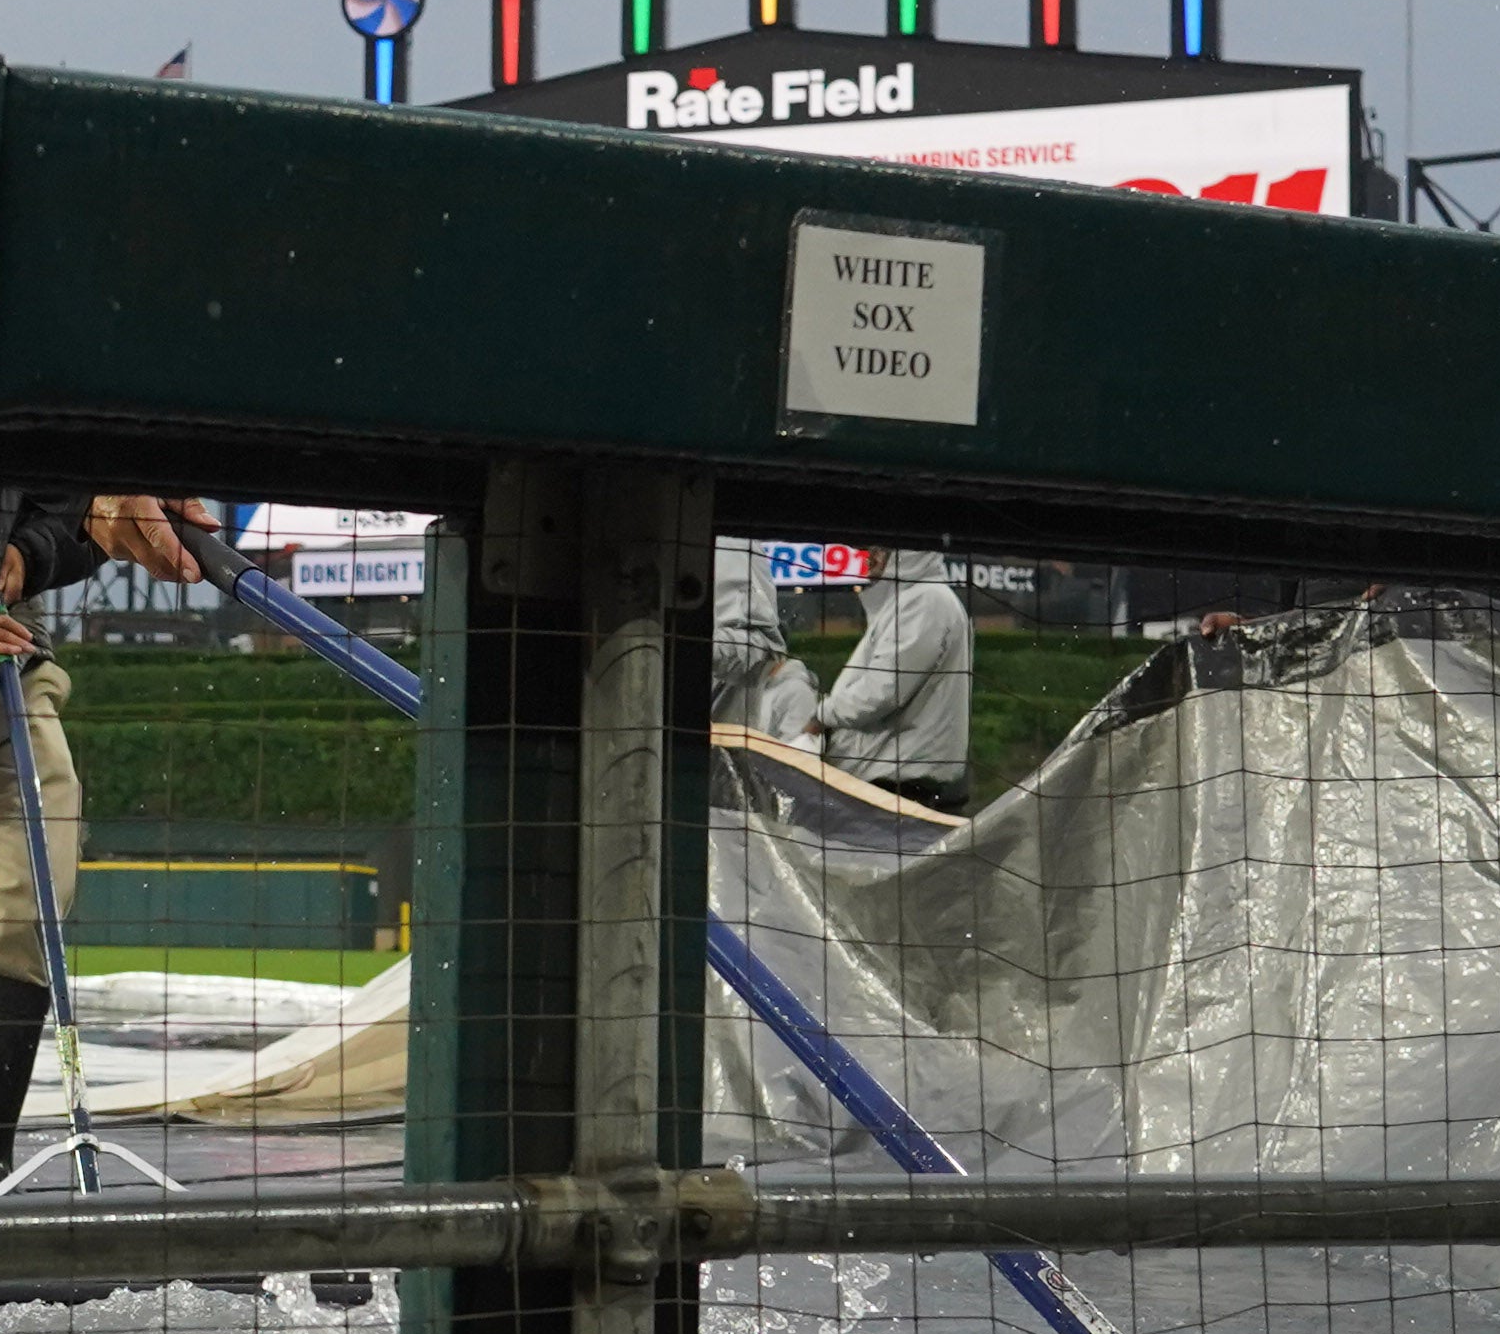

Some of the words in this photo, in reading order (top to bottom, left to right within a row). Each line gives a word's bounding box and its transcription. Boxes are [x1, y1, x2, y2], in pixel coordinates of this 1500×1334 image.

[626, 70, 764, 129] Rate
[772, 63, 914, 120] Field
[986, 141, 1076, 167] SERVICE
[834, 254, 934, 289] WHITE
[852, 301, 915, 332] SOX
[834, 345, 931, 379] VIDEO
[301, 562, 348, 584] DONE
[355, 562, 409, 583] RIGHT
[771, 544, 870, 579] RS91
[971, 564, 1035, 593] DECK
